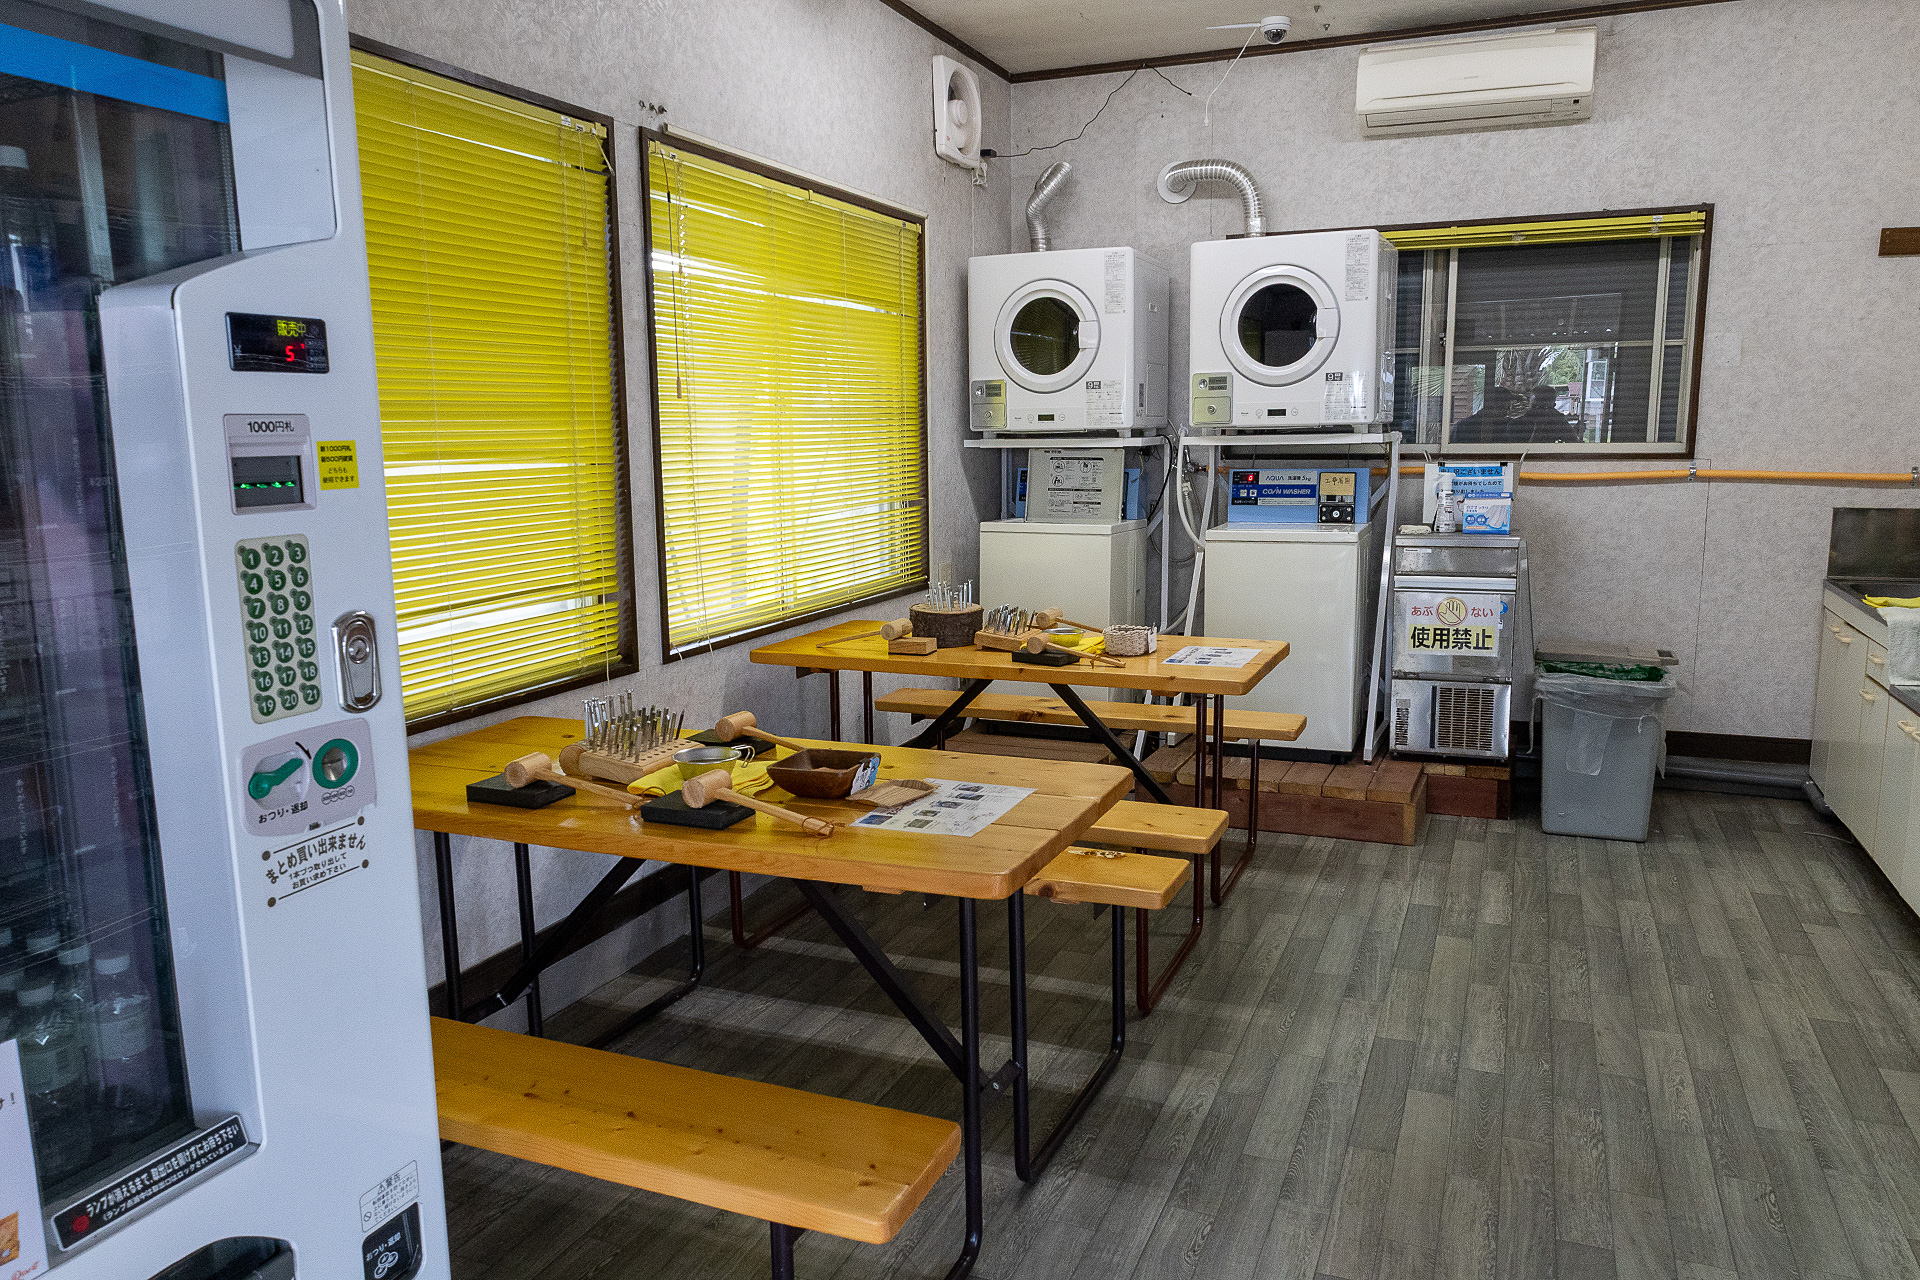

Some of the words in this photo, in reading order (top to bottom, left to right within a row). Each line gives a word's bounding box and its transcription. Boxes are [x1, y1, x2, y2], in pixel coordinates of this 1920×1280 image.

[277, 320, 306, 337] 販売中
[247, 421, 294, 432] 1000円札
[1262, 486, 1281, 495] COIN
[249, 554, 254, 565] 1
[272, 550, 280, 562] 2
[294, 548, 301, 560] 3
[250, 578, 258, 590] 4
[274, 574, 281, 587] 5
[297, 571, 304, 583] 6
[254, 602, 261, 614] 7
[277, 599, 284, 611] 8
[300, 595, 306, 607] 9
[1411, 606, 1433, 617] あぶ
[1471, 606, 1494, 618] ない
[254, 627, 266, 638] 10
[277, 623, 289, 634] 11
[300, 619, 311, 630] 12
[1410, 626, 1493, 650] 使用禁止
[257, 651, 269, 663] 13
[280, 647, 292, 658] 14
[302, 642, 313, 654] 15
[259, 675, 271, 687] 16
[282, 671, 294, 682] 17
[304, 665, 316, 677] 18
[262, 700, 274, 712] 19
[284, 694, 296, 706] 20
[307, 689, 318, 700] 21
[258, 801, 308, 824] おつり・返却
[266, 833, 366, 884] まとめ買い出来ません
[292, 863, 347, 890] お買い求め下さい
